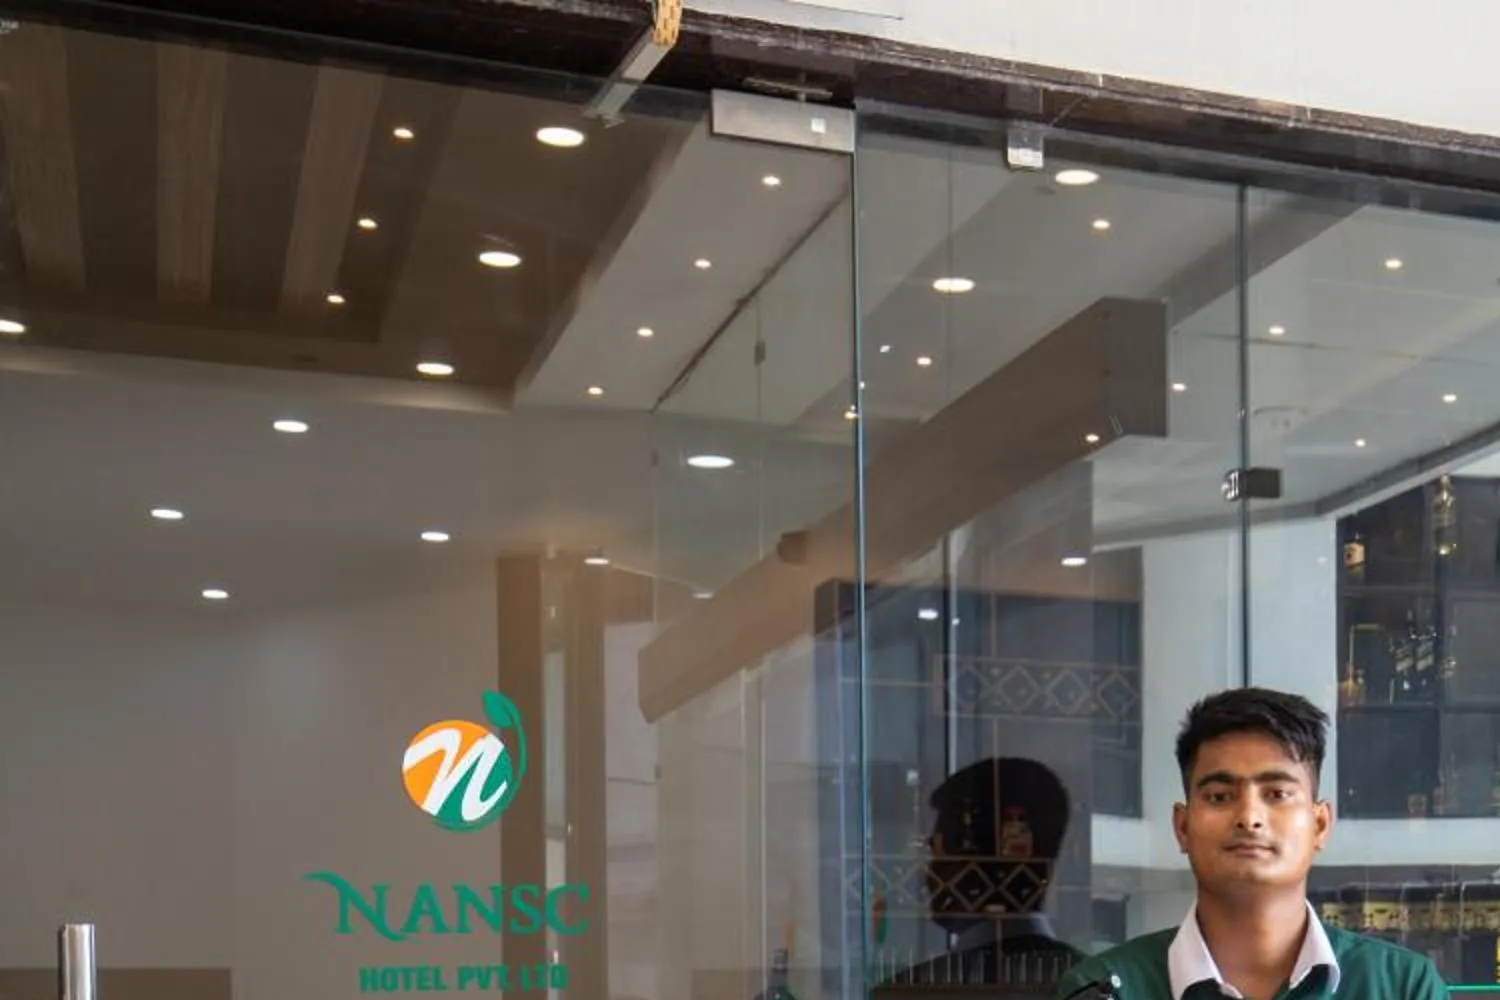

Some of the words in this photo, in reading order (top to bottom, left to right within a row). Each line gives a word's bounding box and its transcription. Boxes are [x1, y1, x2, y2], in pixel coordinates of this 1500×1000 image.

[302, 869, 591, 942] NANSC
[359, 966, 448, 992] HOTEL
[519, 964, 569, 990] LTD
